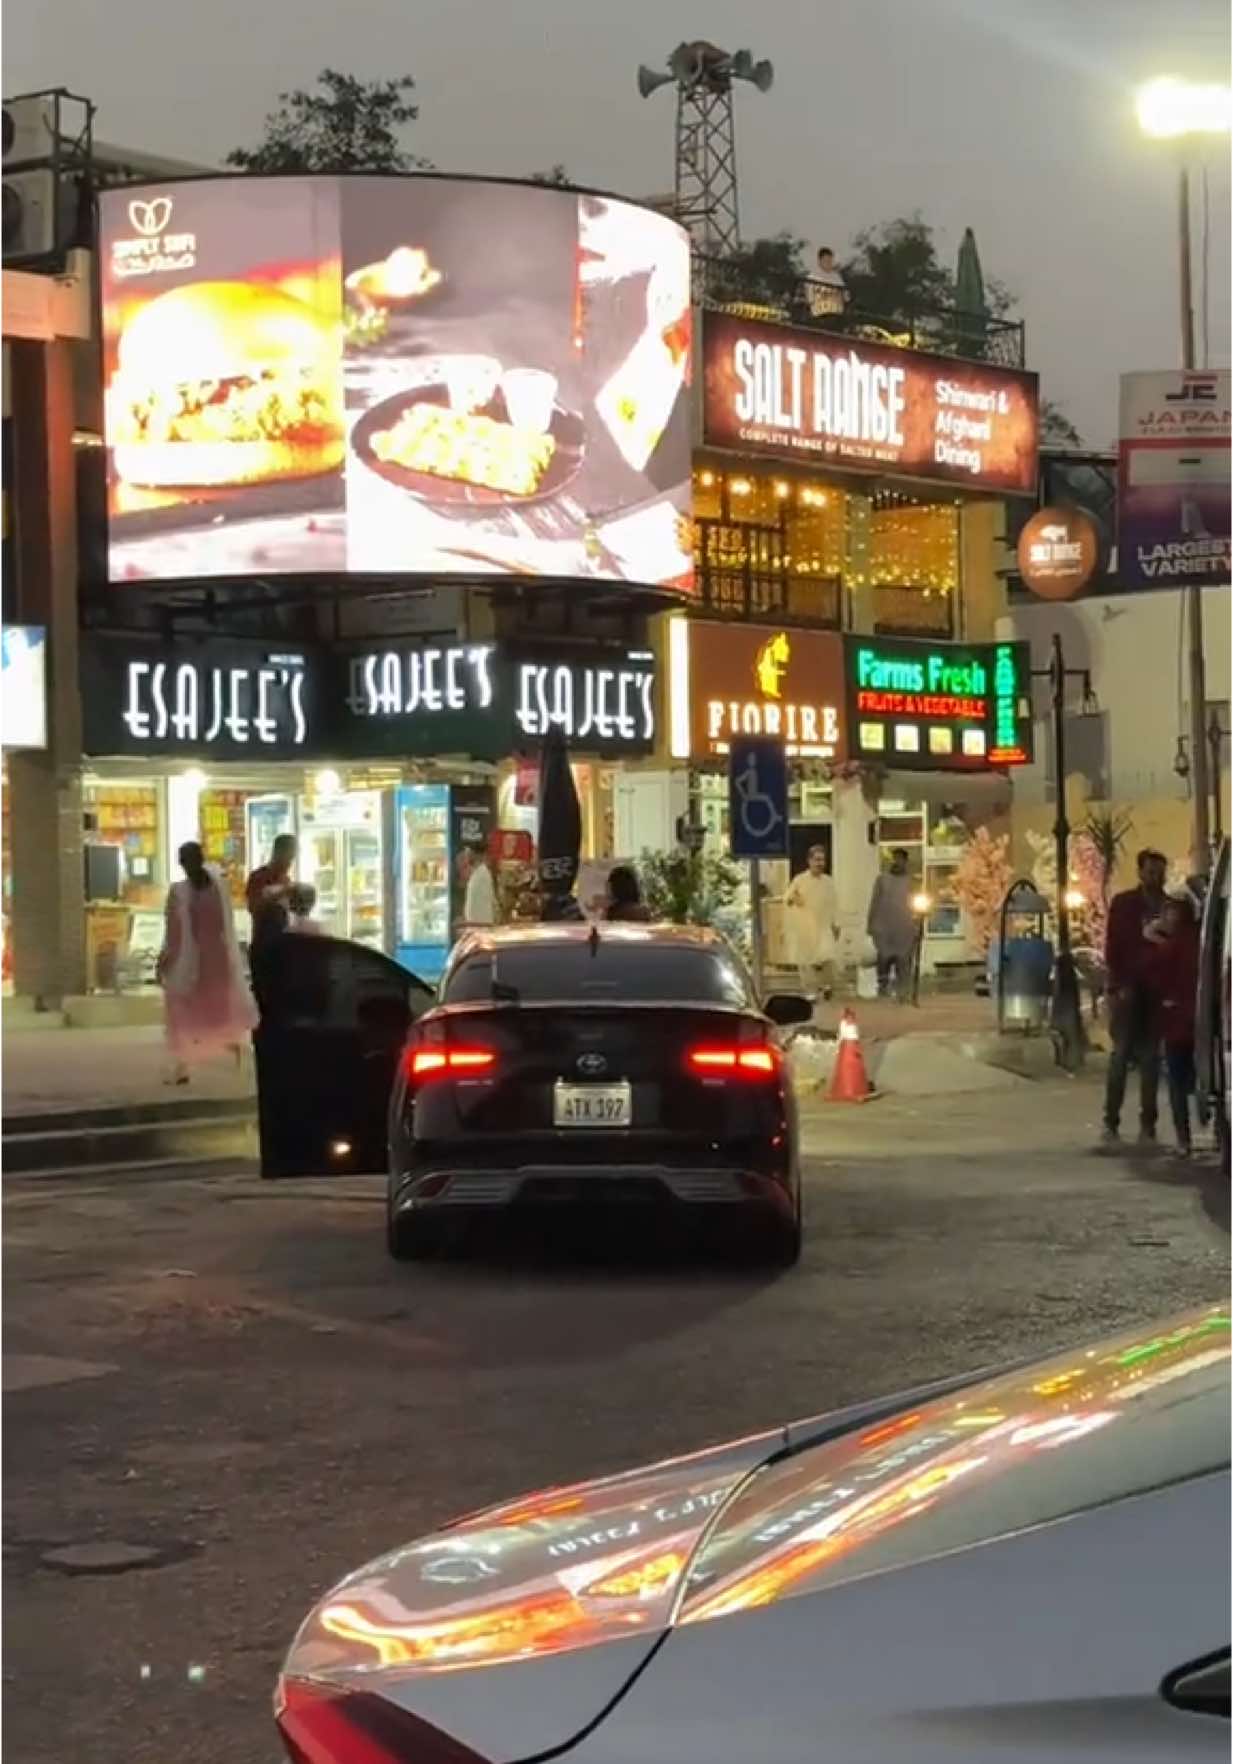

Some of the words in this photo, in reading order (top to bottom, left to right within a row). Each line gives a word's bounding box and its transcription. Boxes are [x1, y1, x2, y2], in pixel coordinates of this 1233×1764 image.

[735, 338, 806, 430] SALT
[812, 349, 905, 447] RANGE
[935, 439, 981, 475] Dining
[123, 661, 306, 744] ESAJEE'S
[515, 664, 655, 740] ESAJEE'S
[858, 650, 923, 691] Farms
[928, 656, 986, 695] Fresh
